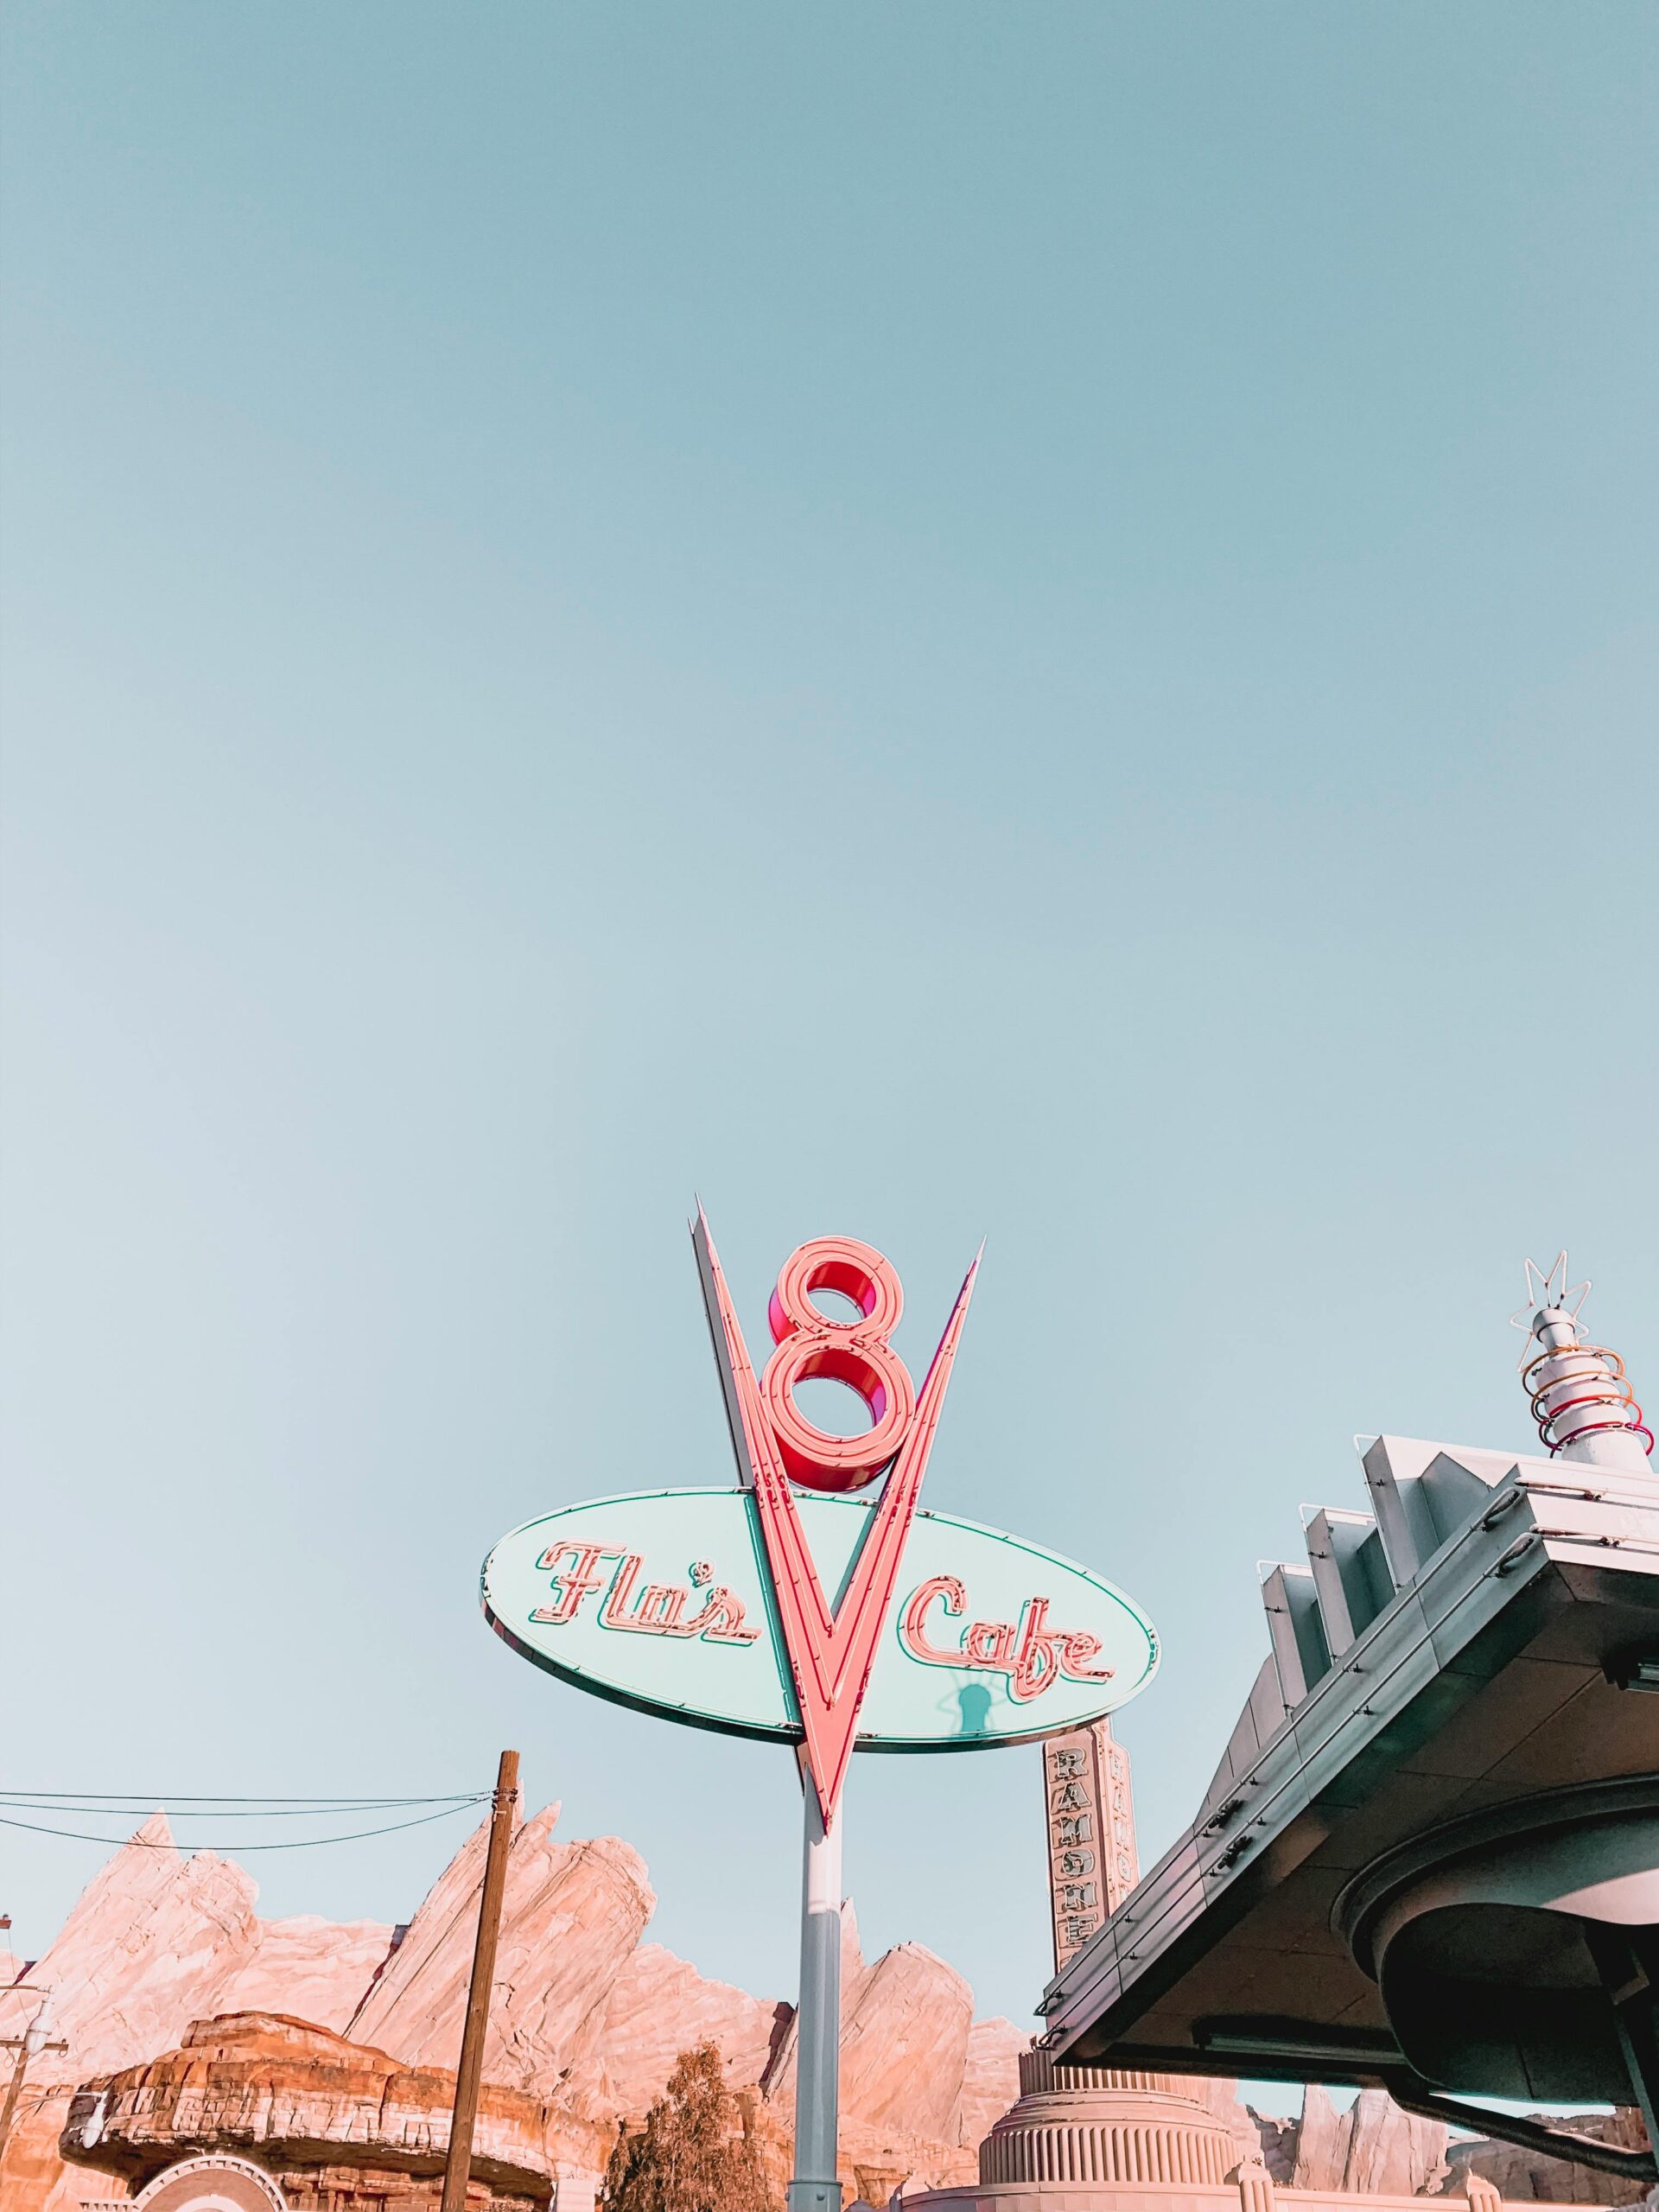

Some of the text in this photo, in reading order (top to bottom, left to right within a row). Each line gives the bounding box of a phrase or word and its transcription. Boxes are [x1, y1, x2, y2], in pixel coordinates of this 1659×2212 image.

[529, 1536, 1117, 1705] Flo's Cafe
[1048, 1746, 1103, 1967] RAMONE
